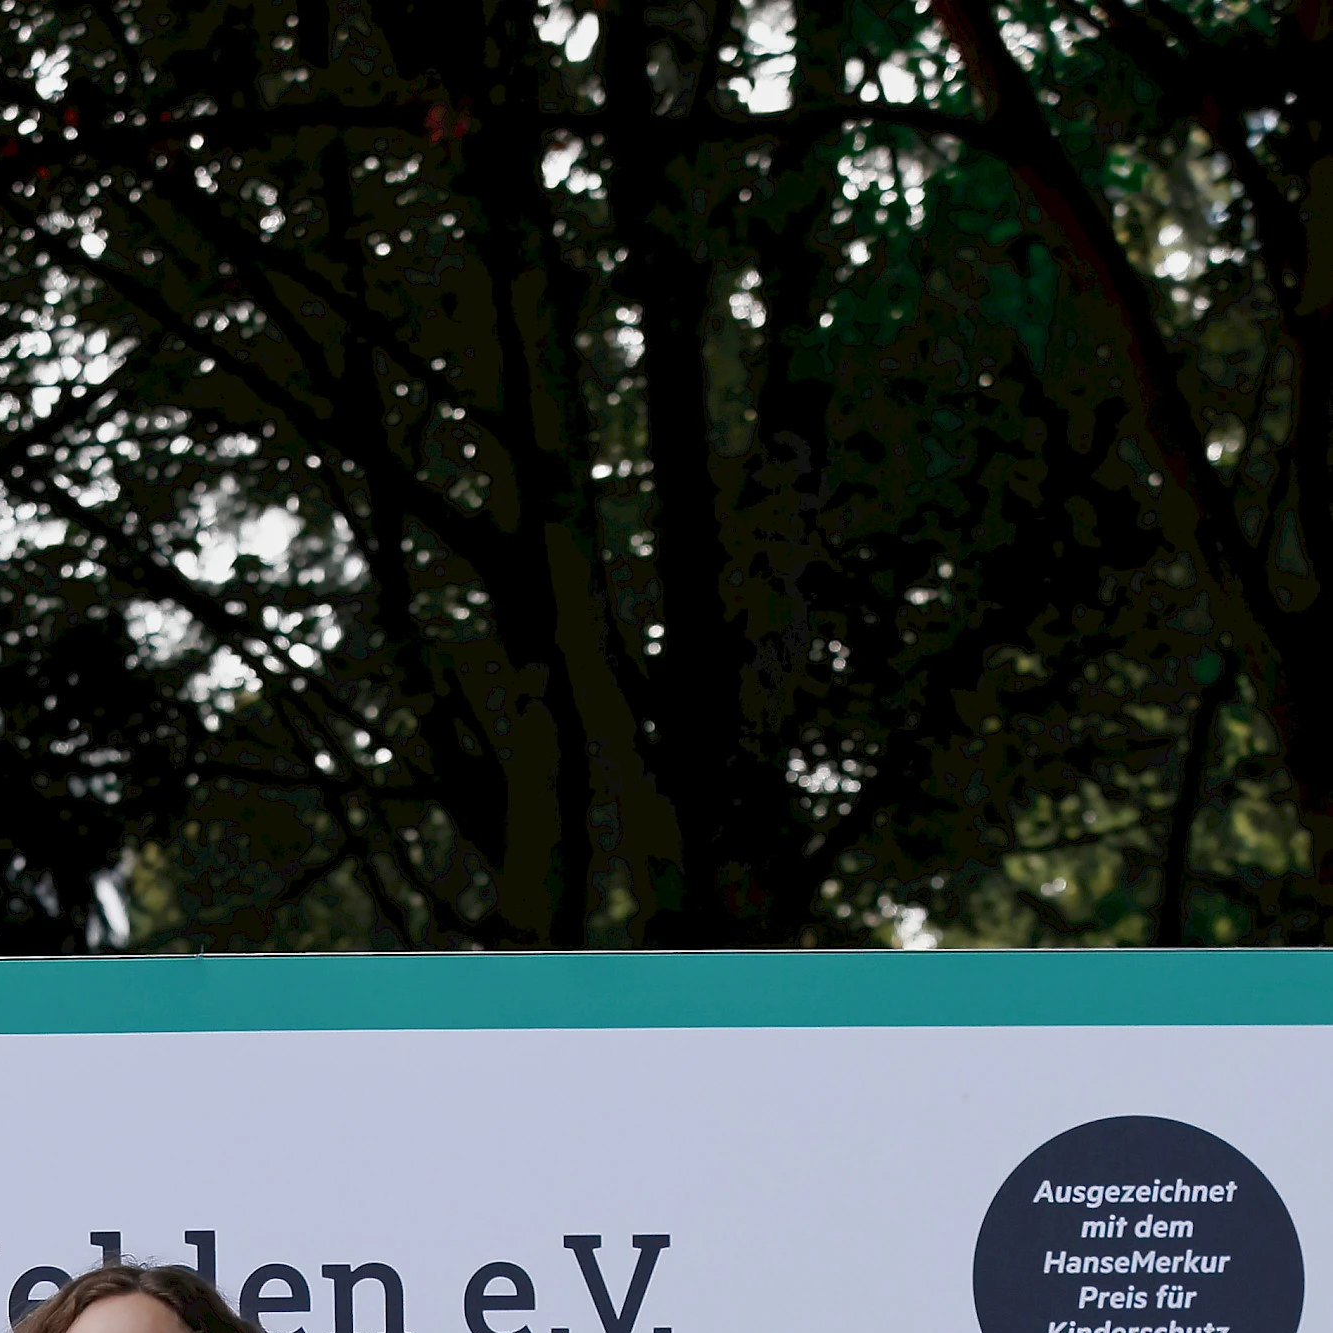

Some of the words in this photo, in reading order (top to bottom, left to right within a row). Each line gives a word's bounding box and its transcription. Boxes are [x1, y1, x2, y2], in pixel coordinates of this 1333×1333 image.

[1032, 1178, 1238, 1209] Ausgezeichnet
[1080, 1214, 1128, 1238] mit
[1134, 1214, 1194, 1238] dem
[1043, 1249, 1231, 1274] HanseMerkur
[1078, 1285, 1148, 1309] Preis
[1156, 1285, 1198, 1309] für
